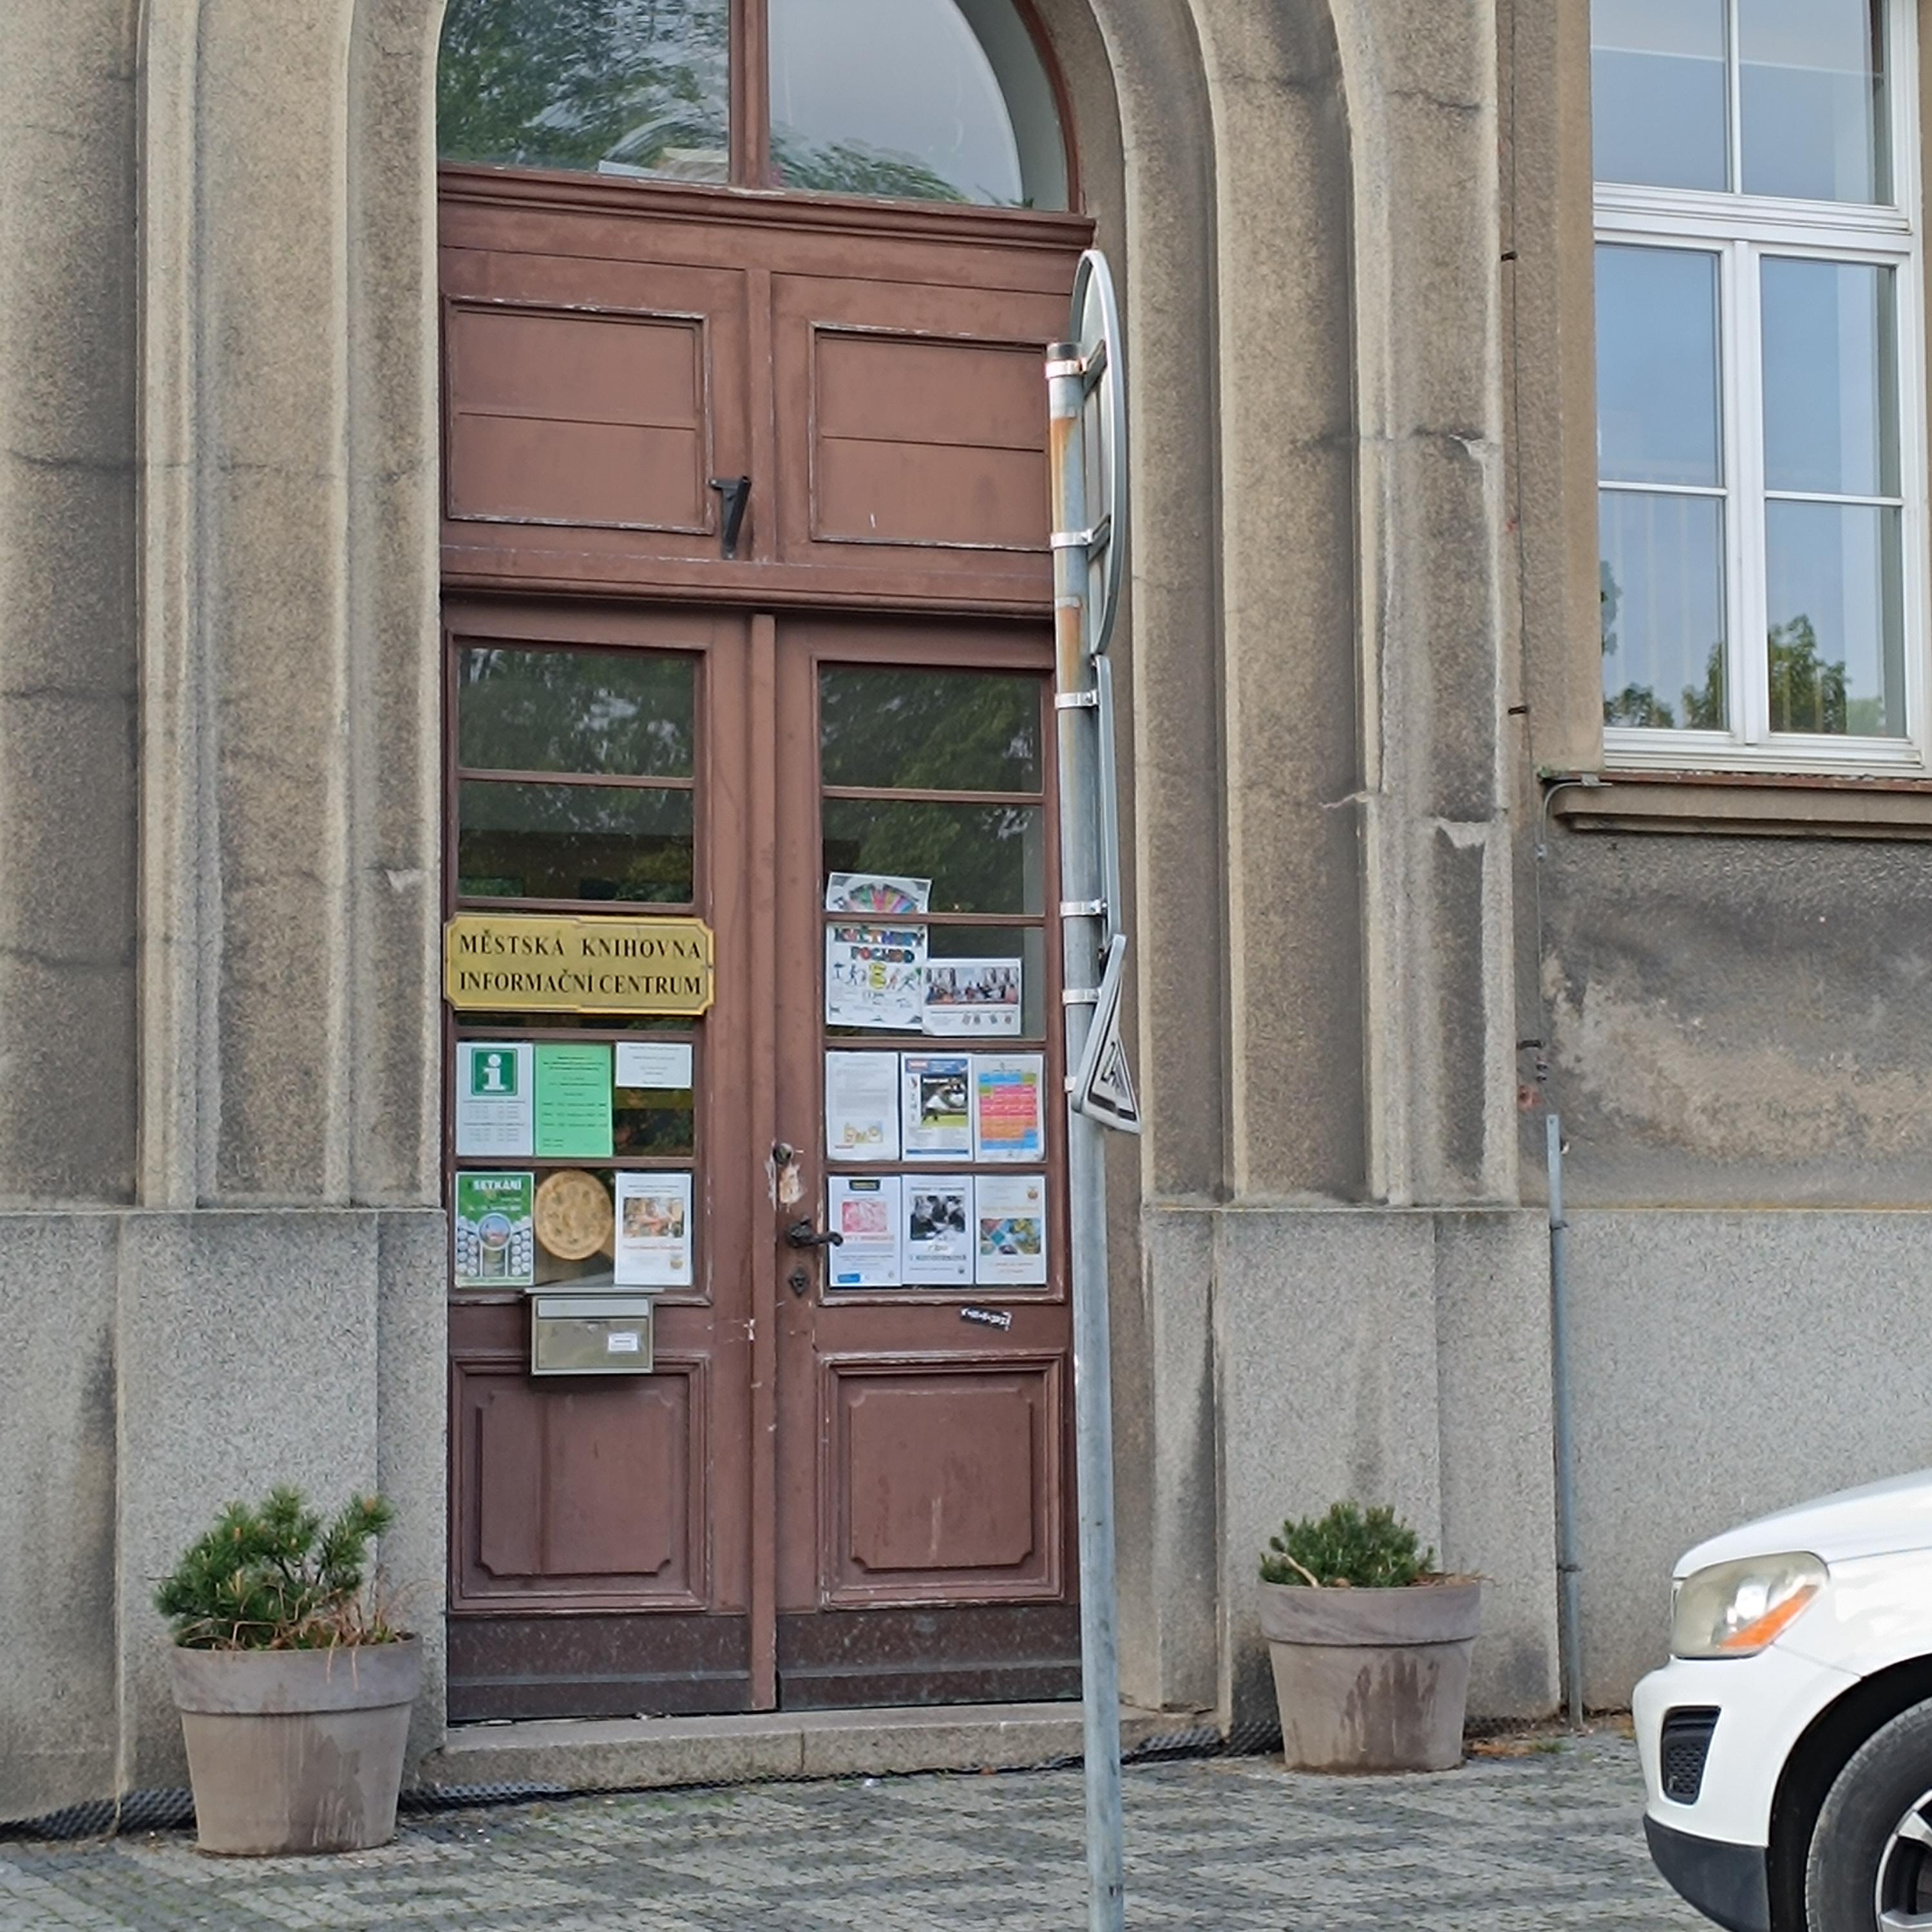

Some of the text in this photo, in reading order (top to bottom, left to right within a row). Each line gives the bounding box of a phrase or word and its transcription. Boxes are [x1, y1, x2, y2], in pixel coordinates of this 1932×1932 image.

[459, 929, 701, 959] MĚSTSKÁ KNIHOVNA
[459, 969, 701, 995] INFORMAČNÍ CENTRUM
